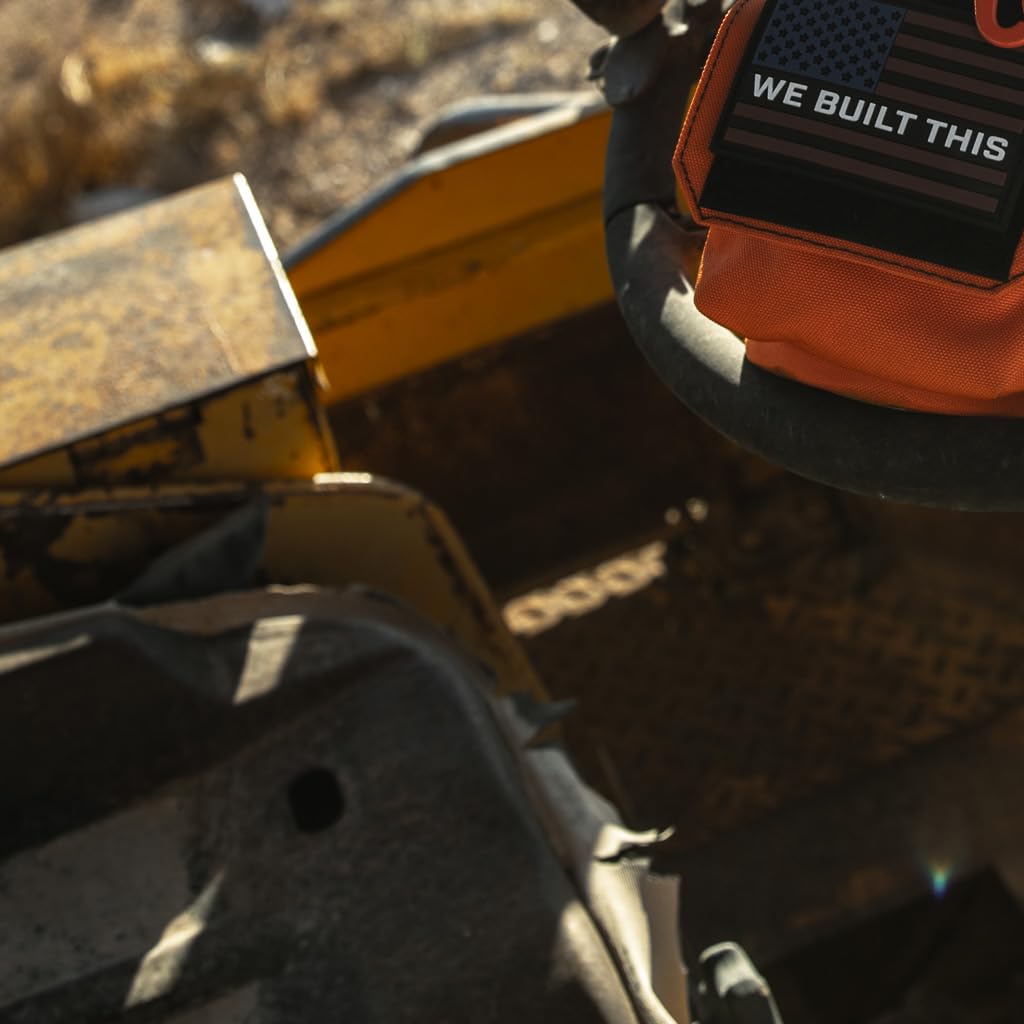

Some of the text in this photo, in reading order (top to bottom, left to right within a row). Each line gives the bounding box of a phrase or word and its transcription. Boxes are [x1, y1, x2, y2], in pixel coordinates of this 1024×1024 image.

[753, 73, 1009, 162] WE BUILT THIS
